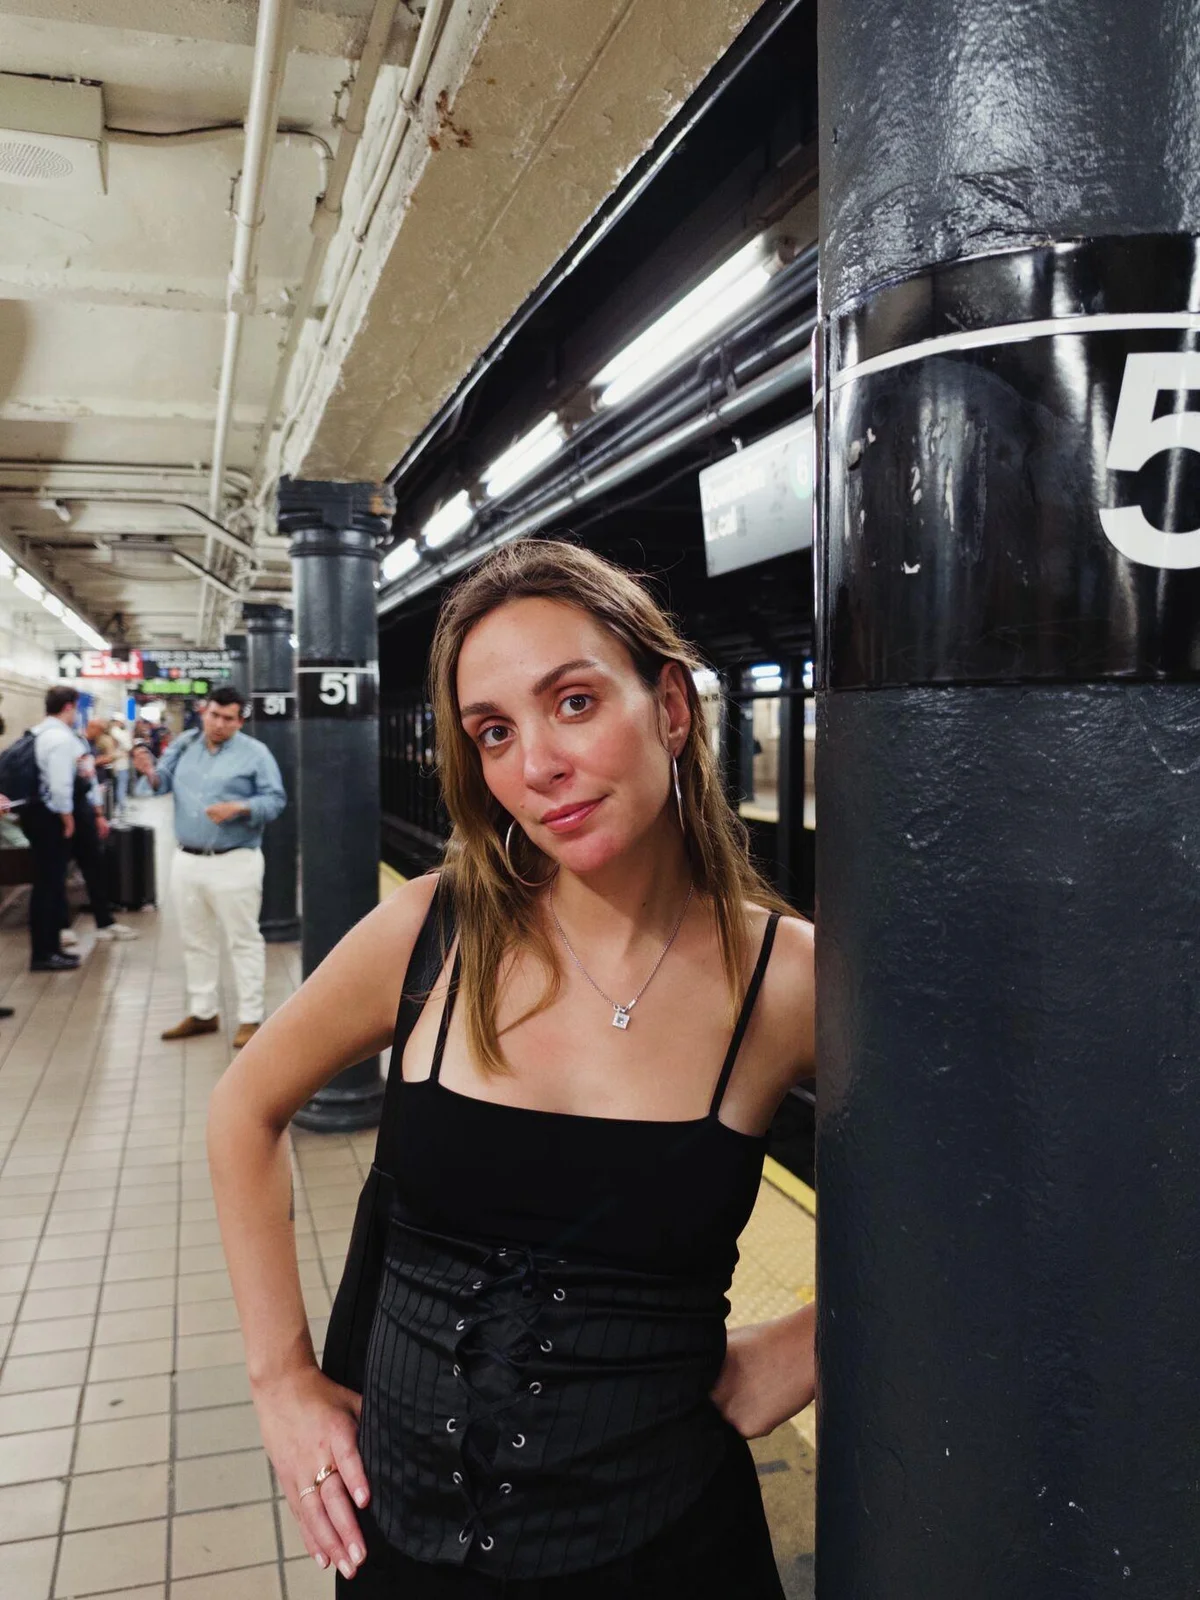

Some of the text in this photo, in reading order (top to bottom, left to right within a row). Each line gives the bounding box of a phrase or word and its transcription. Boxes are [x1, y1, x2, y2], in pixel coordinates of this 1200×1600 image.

[82, 651, 140, 675] Exit
[319, 672, 357, 705] 51
[263, 695, 286, 715] 51
